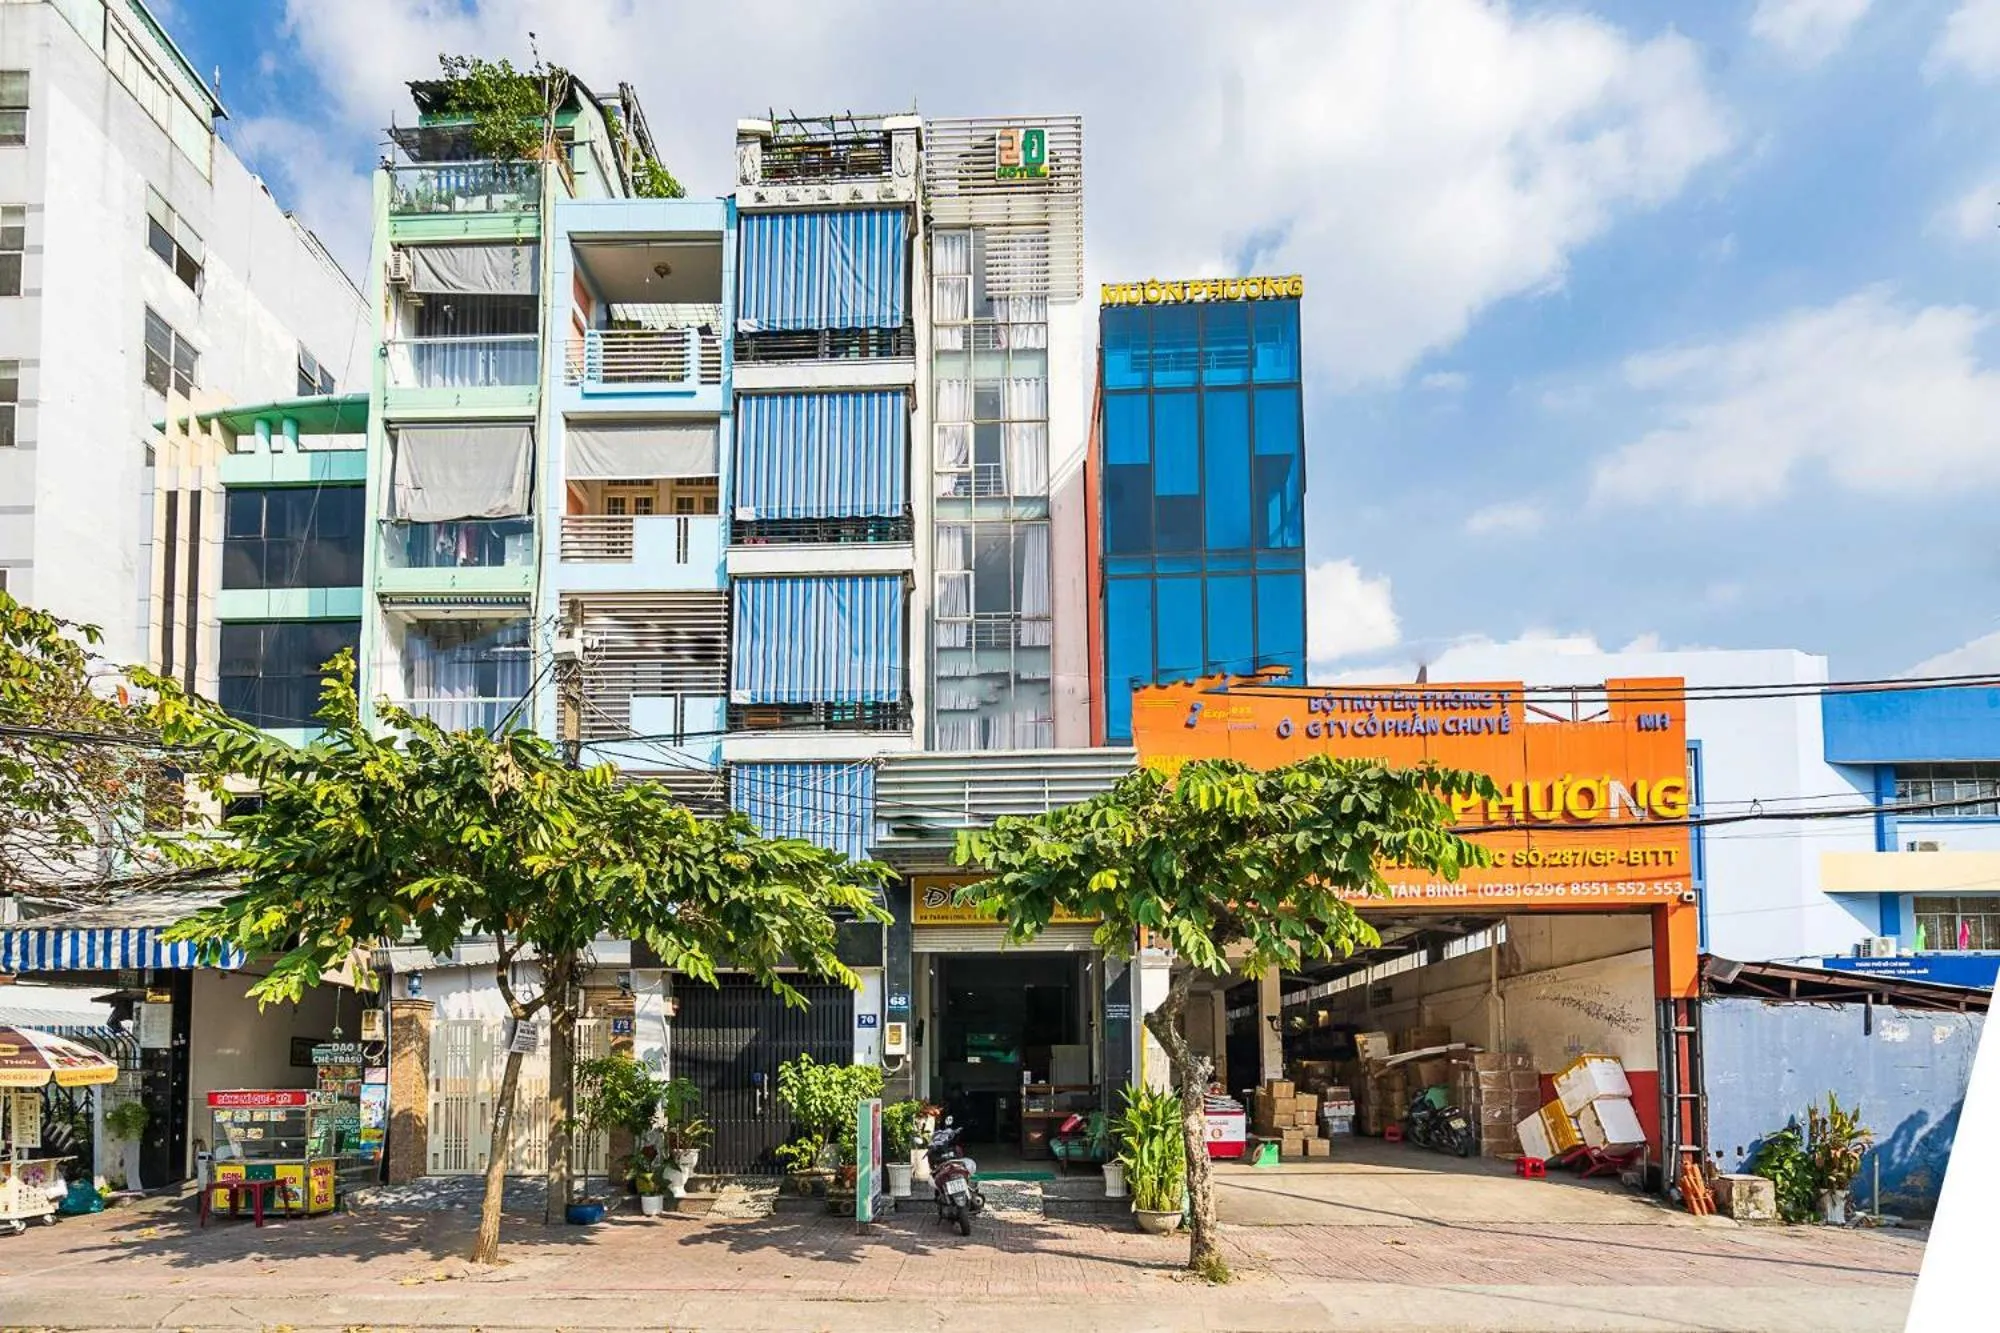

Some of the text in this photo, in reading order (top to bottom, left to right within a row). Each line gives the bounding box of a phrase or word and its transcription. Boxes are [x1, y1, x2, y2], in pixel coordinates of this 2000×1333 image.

[997, 166, 1048, 178] HOTEL
[890, 996, 906, 1005] 68
[860, 1015, 874, 1024] 70
